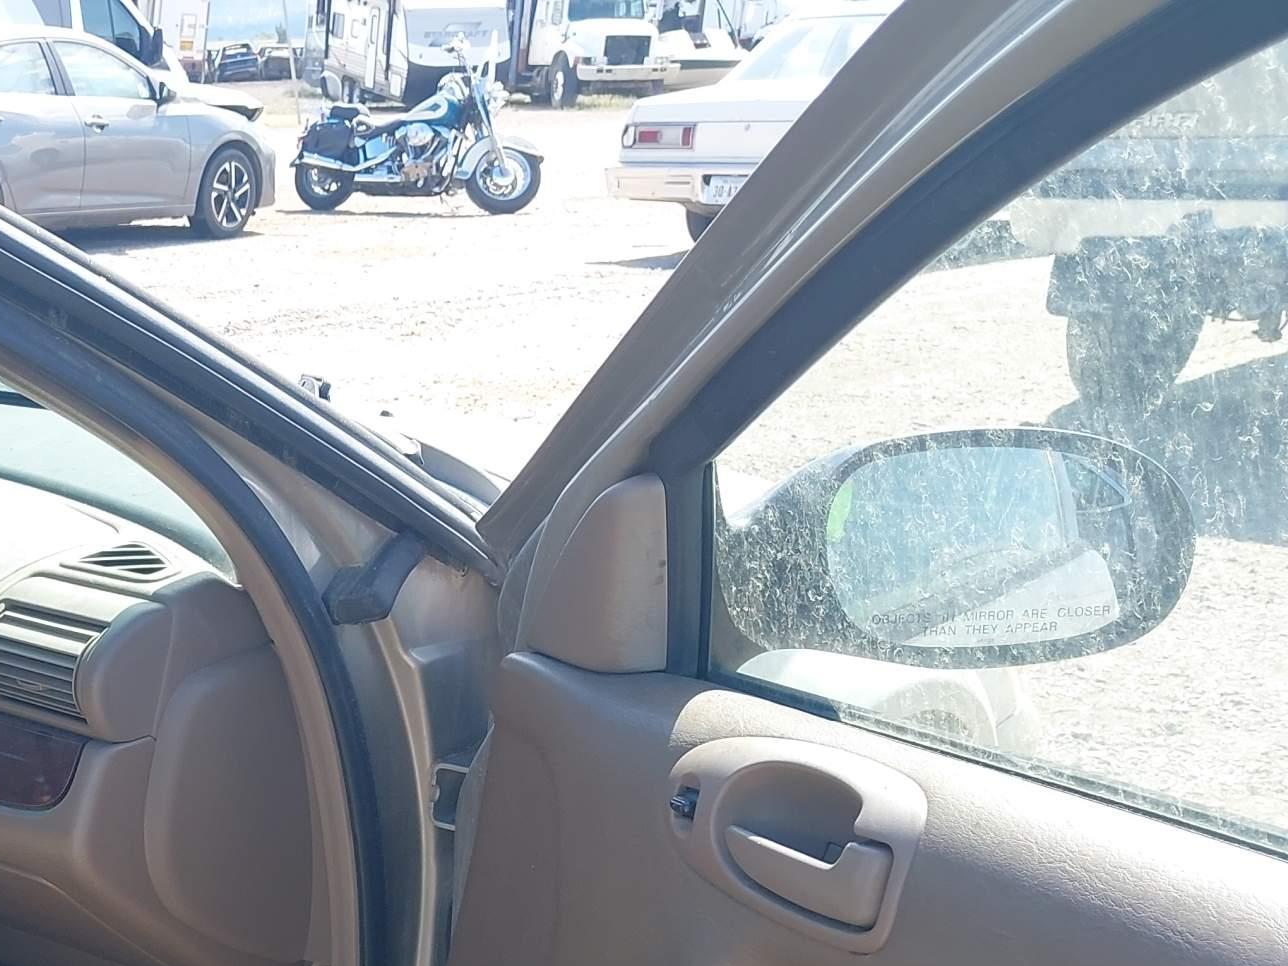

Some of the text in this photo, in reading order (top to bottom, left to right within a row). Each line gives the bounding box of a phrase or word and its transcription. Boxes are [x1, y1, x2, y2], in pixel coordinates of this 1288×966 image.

[964, 610, 1014, 622] MIRROR
[1022, 608, 1048, 619] ARE
[1057, 605, 1111, 618] CLOSER
[922, 621, 1058, 637] THAN THEY APPEAR
